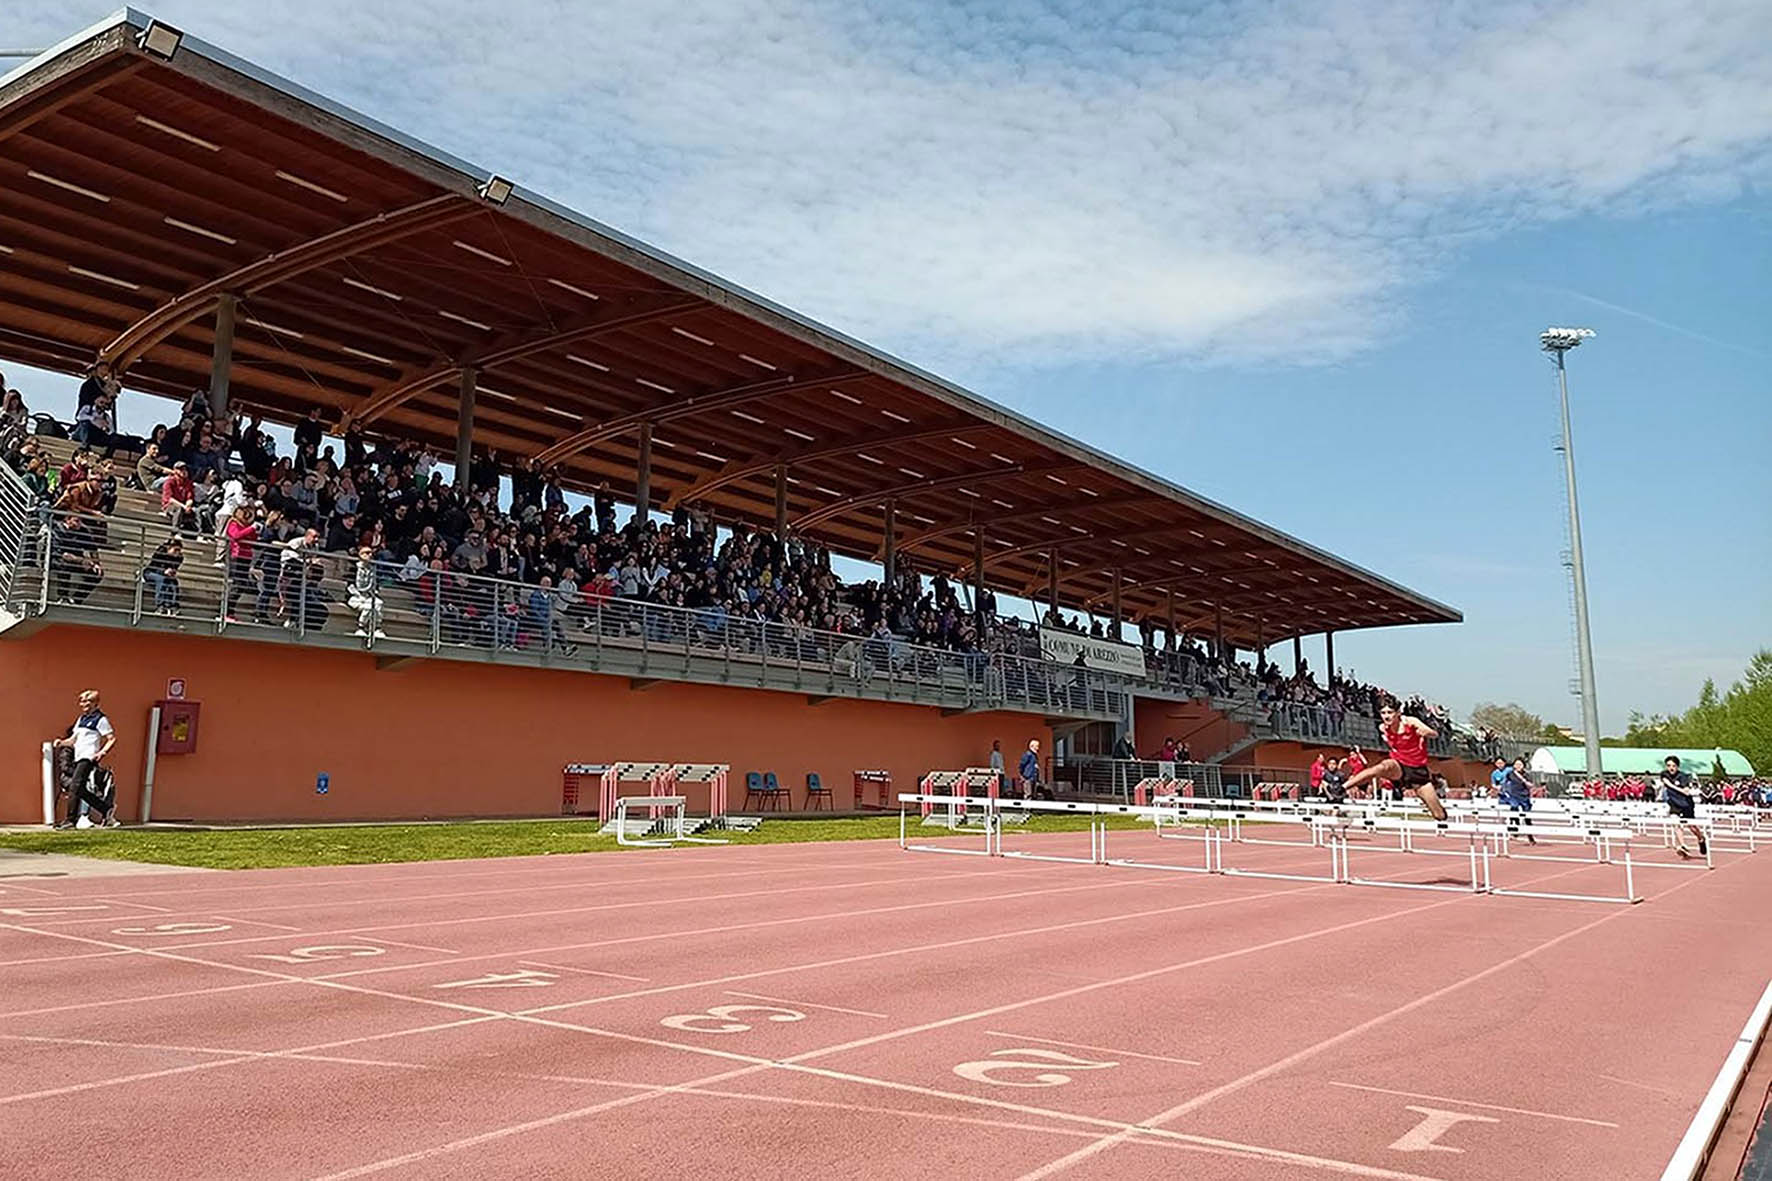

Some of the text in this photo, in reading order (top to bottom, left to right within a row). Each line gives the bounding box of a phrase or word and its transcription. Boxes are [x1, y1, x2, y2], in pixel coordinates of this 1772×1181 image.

[111, 922, 232, 936] 6
[247, 945, 386, 964] 5
[433, 969, 560, 989] 4
[660, 1004, 806, 1034] 3
[952, 1048, 1120, 1088] 2
[1387, 1105, 1501, 1153] 1
